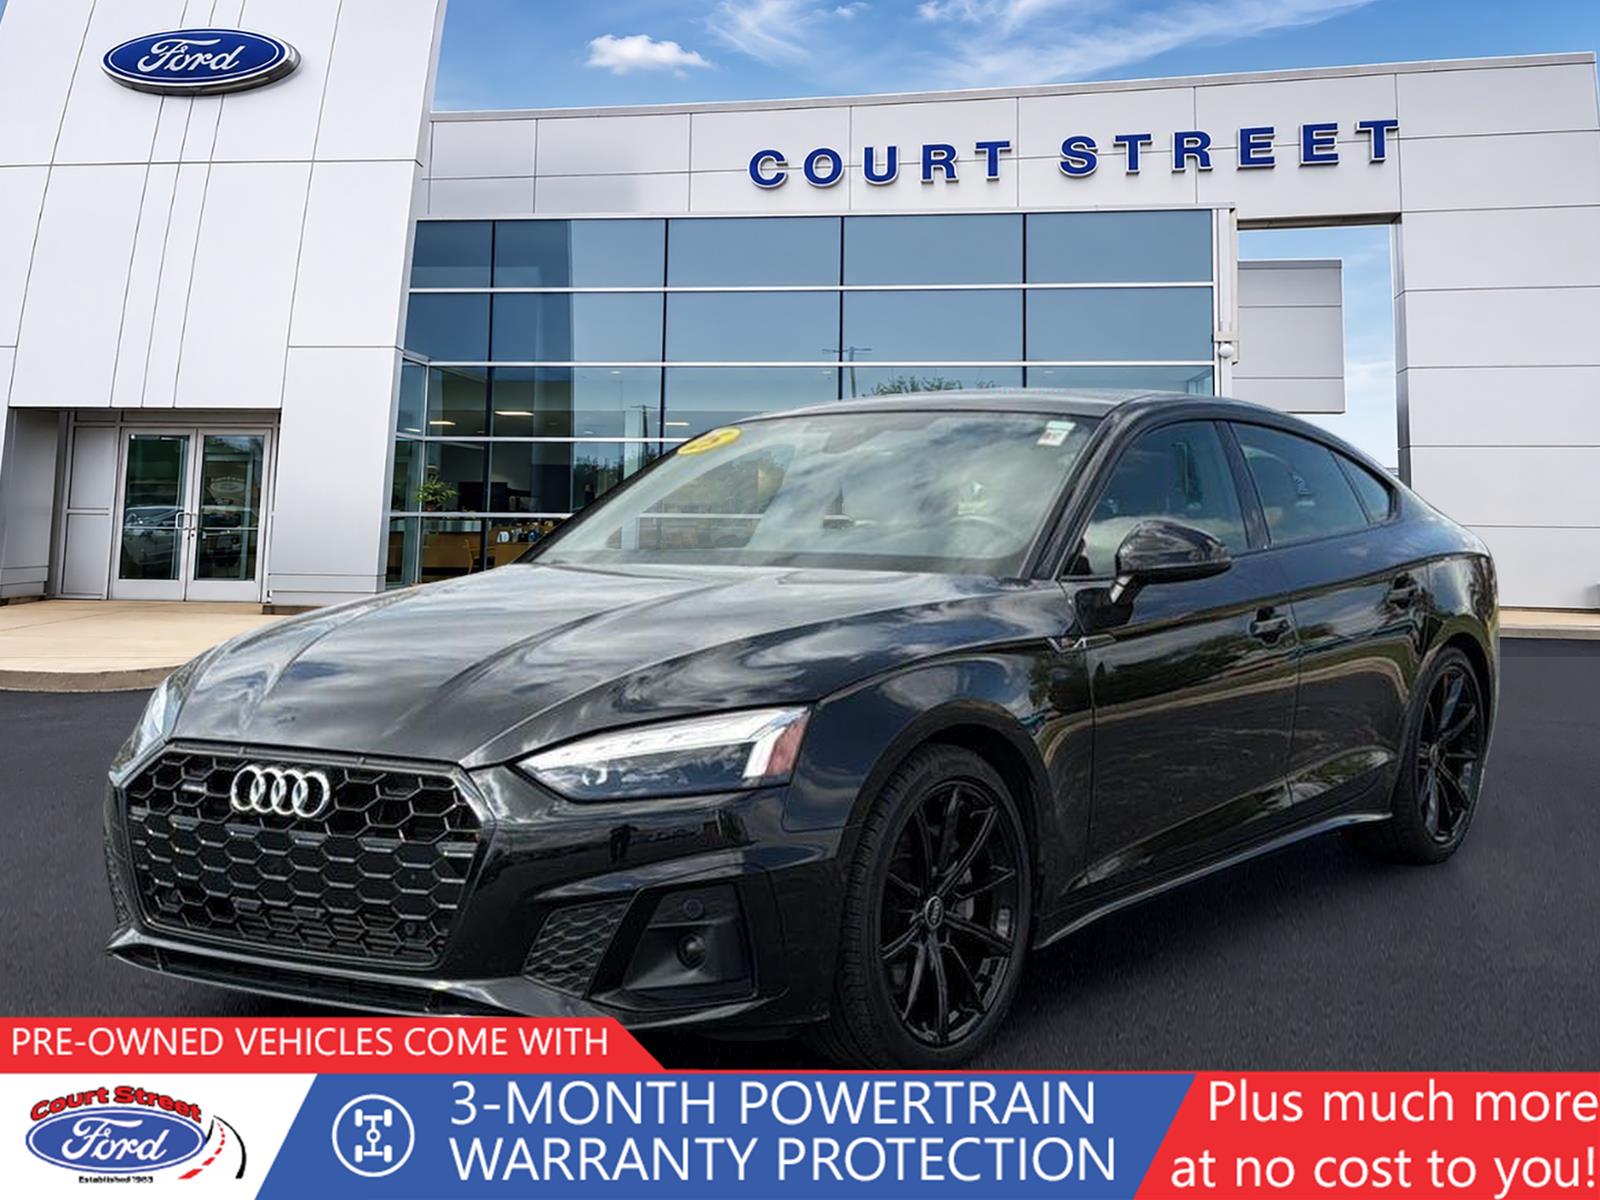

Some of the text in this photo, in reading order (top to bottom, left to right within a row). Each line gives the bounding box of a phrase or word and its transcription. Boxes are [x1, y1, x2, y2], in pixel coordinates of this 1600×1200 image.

[137, 38, 246, 72] Ford
[748, 119, 1399, 188] COURT STREET
